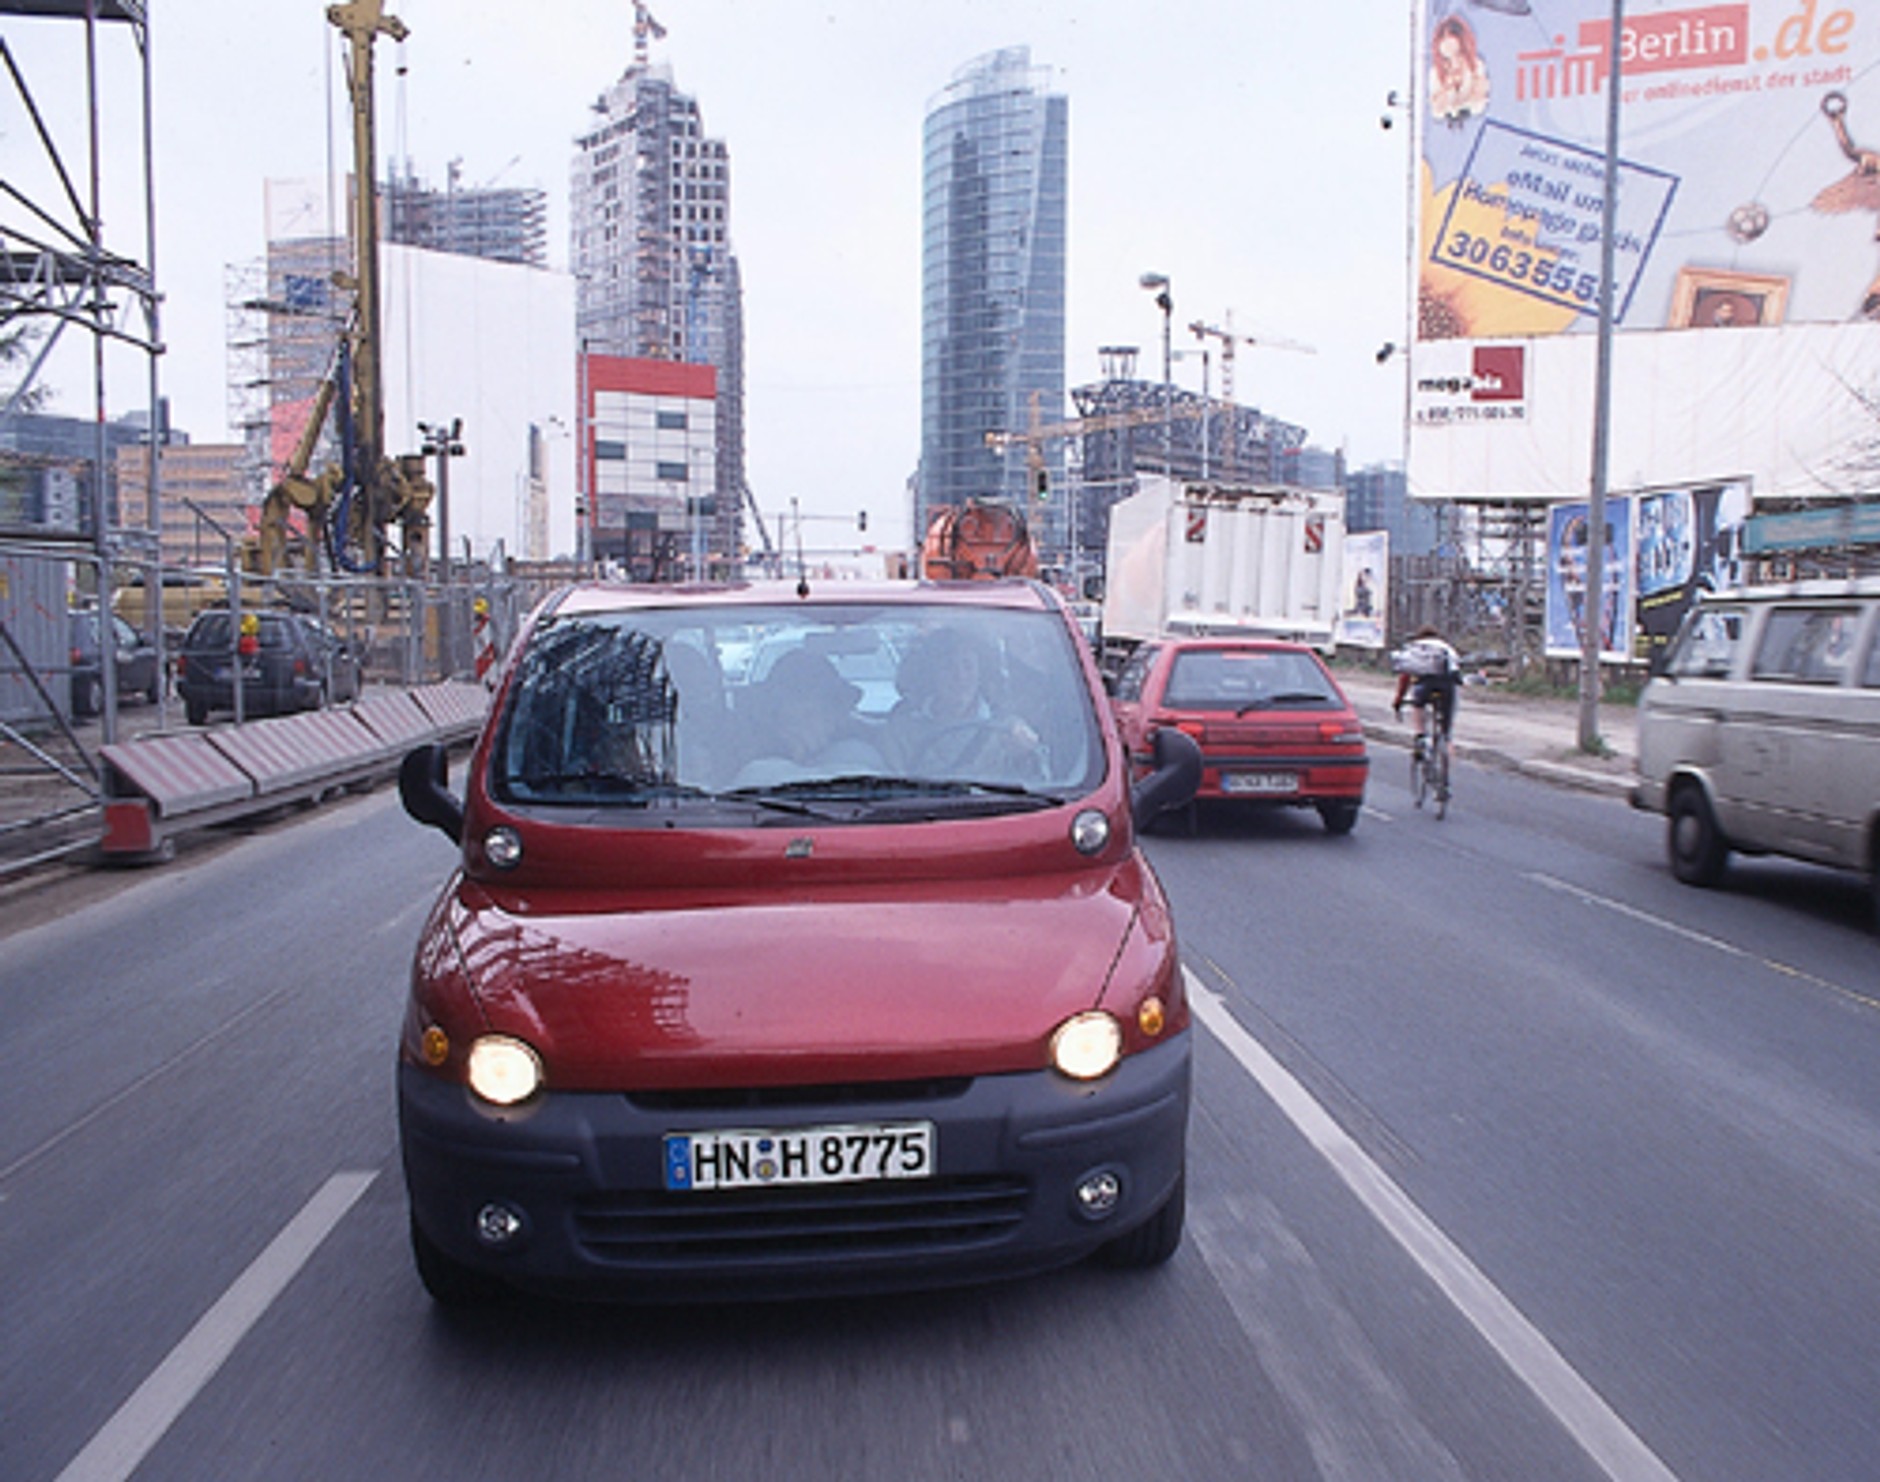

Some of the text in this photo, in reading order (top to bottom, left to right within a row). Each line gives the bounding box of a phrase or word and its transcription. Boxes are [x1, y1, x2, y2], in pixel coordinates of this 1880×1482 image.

[1619, 20, 1736, 62] Berlin
[1765, 70, 1796, 89] der
[1802, 64, 1853, 86] stadt
[1574, 193, 1612, 213] un
[694, 1131, 926, 1182] HN H 8775
